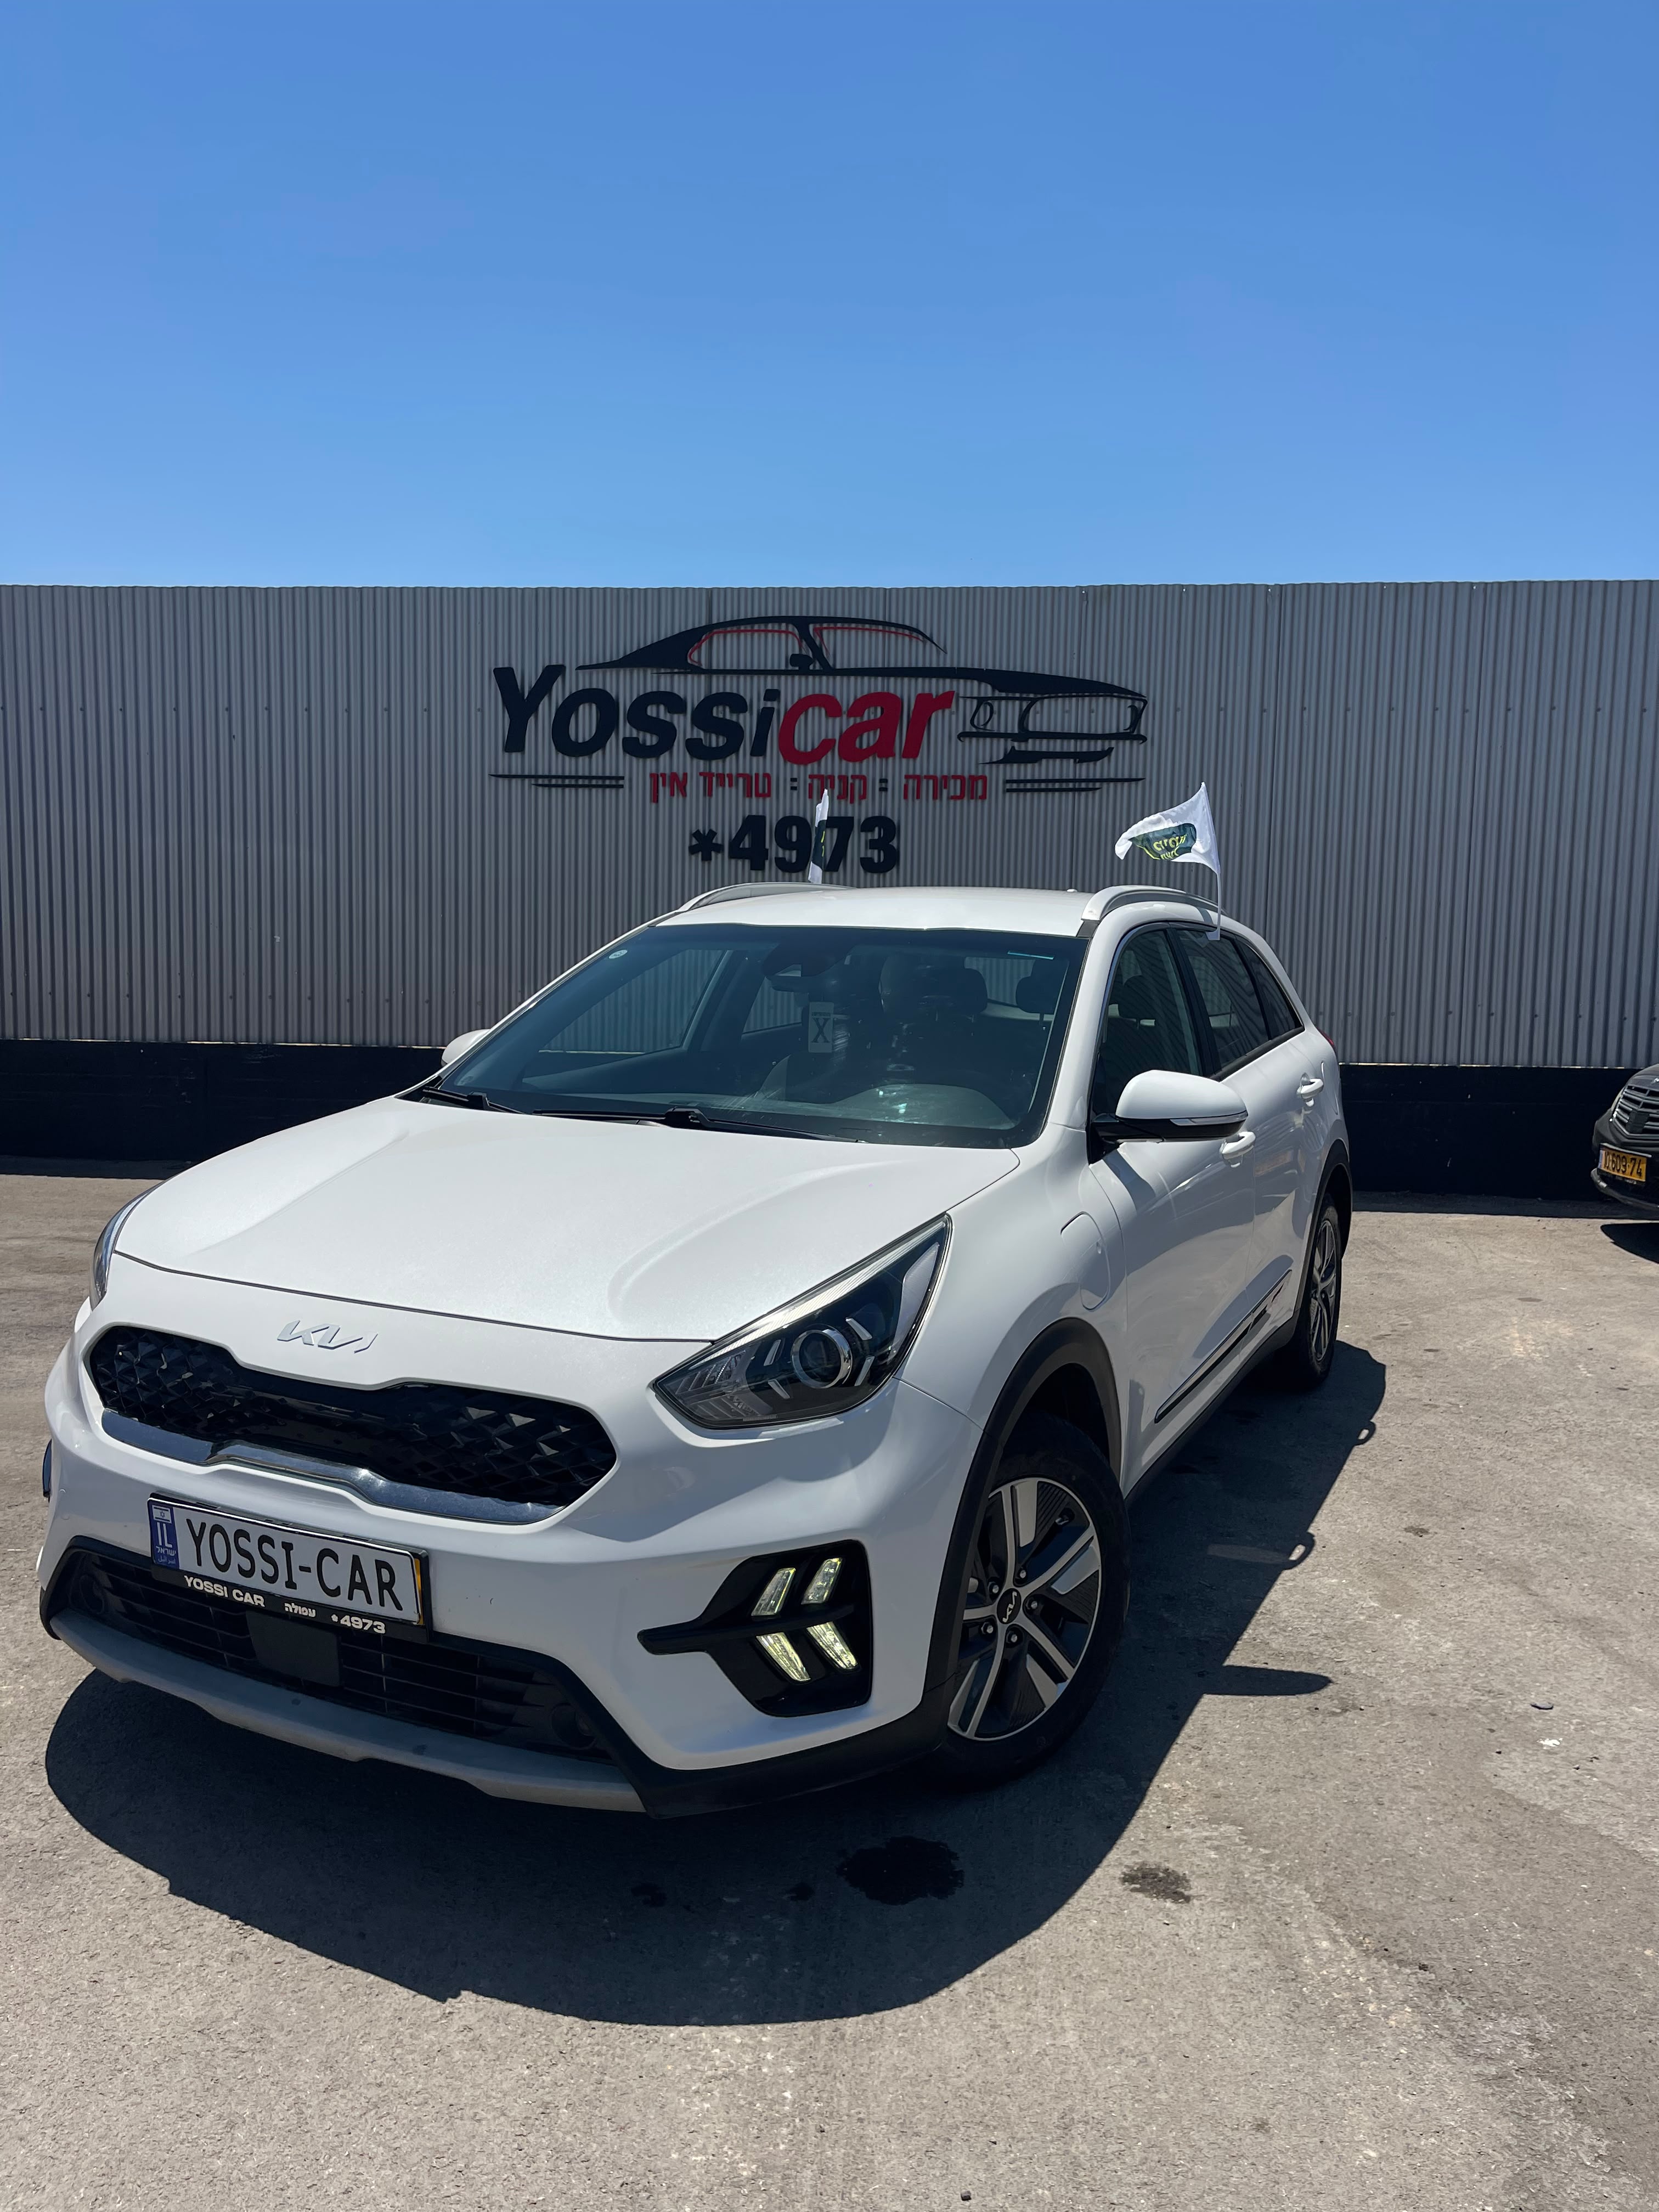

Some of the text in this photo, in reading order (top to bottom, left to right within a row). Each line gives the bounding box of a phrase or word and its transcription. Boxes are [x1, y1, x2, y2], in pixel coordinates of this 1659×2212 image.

[650, 771, 689, 804] אין
[699, 772, 772, 798] טרייד
[808, 773, 868, 804] קניה
[903, 774, 988, 802] מכירה
[157, 1522, 173, 1548] IL
[156, 1546, 177, 1556] ישראל
[186, 1518, 403, 1611] YOSSI-CAR
[184, 1575, 265, 1607] YOSSI CAR
